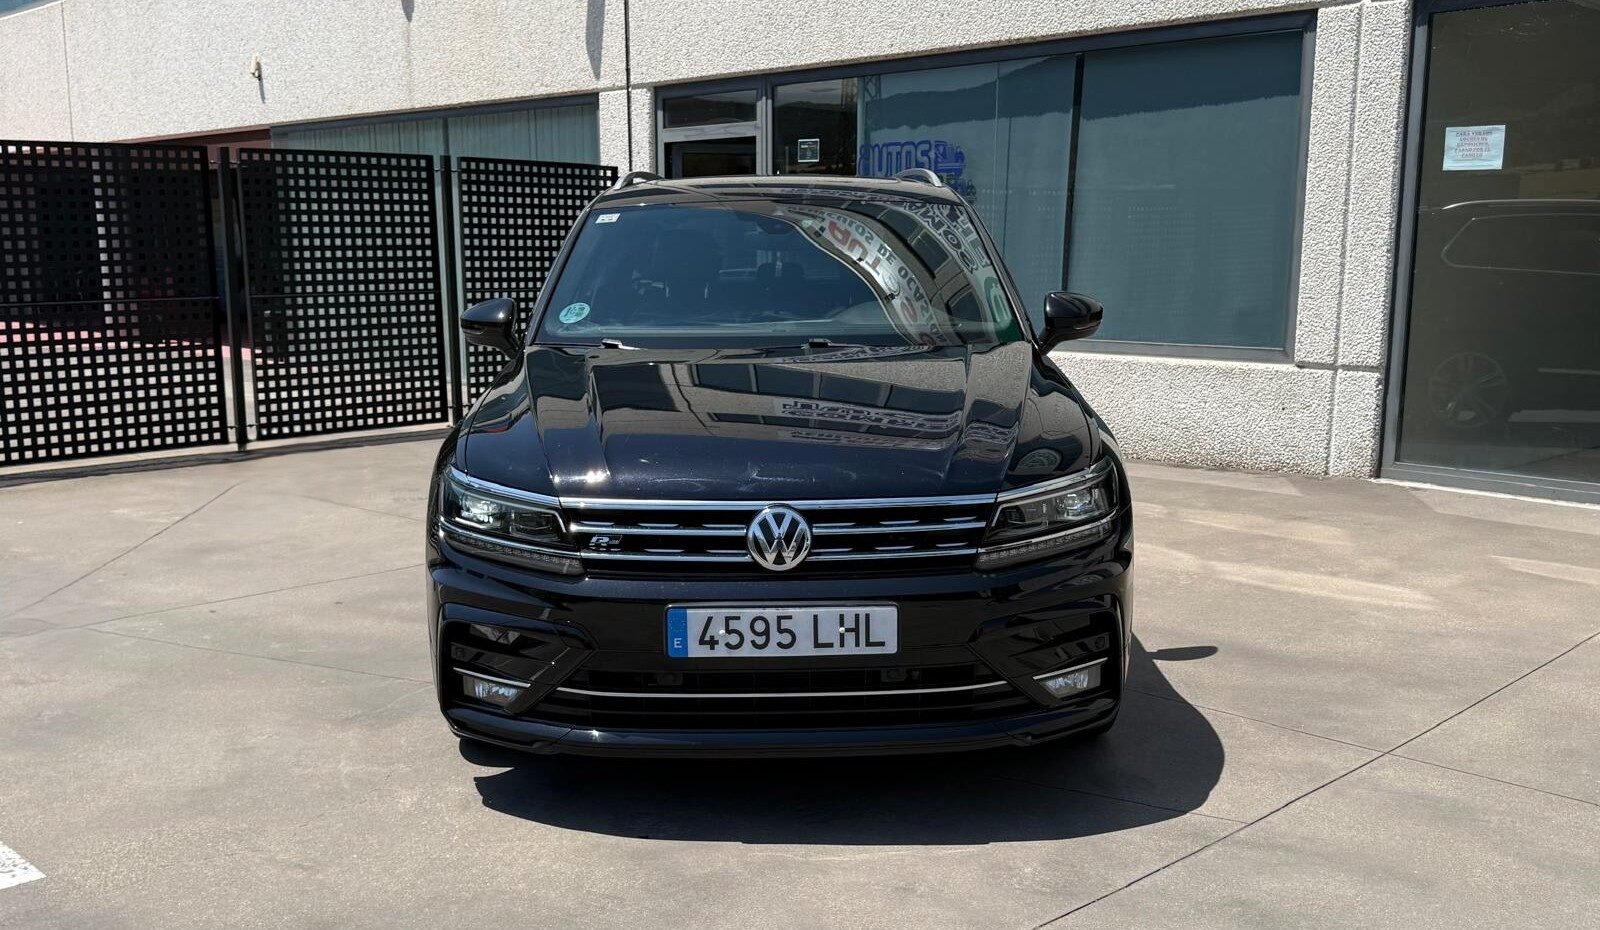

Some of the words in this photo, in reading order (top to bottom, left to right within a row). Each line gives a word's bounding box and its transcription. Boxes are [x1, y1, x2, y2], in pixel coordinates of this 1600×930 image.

[673, 638, 682, 649] E
[698, 615, 797, 650] 4595
[813, 613, 886, 649] LHL
